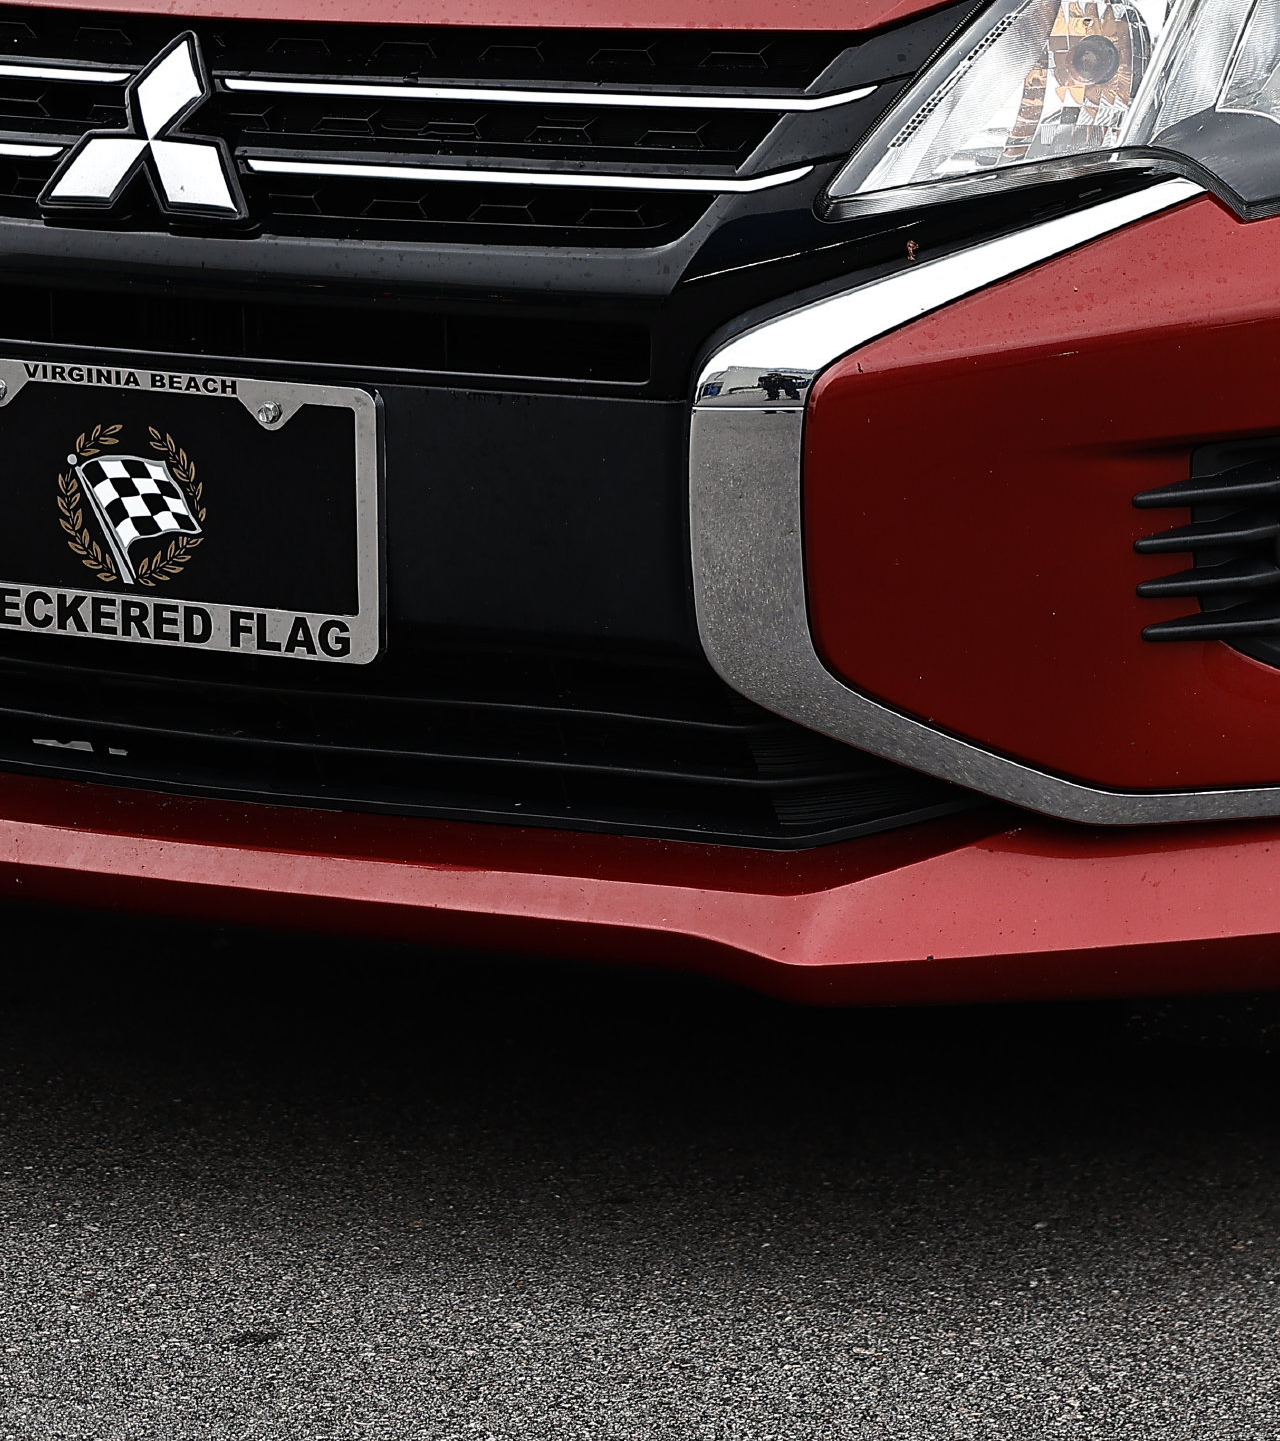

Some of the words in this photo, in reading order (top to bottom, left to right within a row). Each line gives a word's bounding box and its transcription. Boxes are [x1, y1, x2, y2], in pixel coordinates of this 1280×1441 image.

[23, 362, 142, 388] VIRGINIA
[150, 372, 238, 396] BEACH
[229, 610, 352, 658] FLAG
